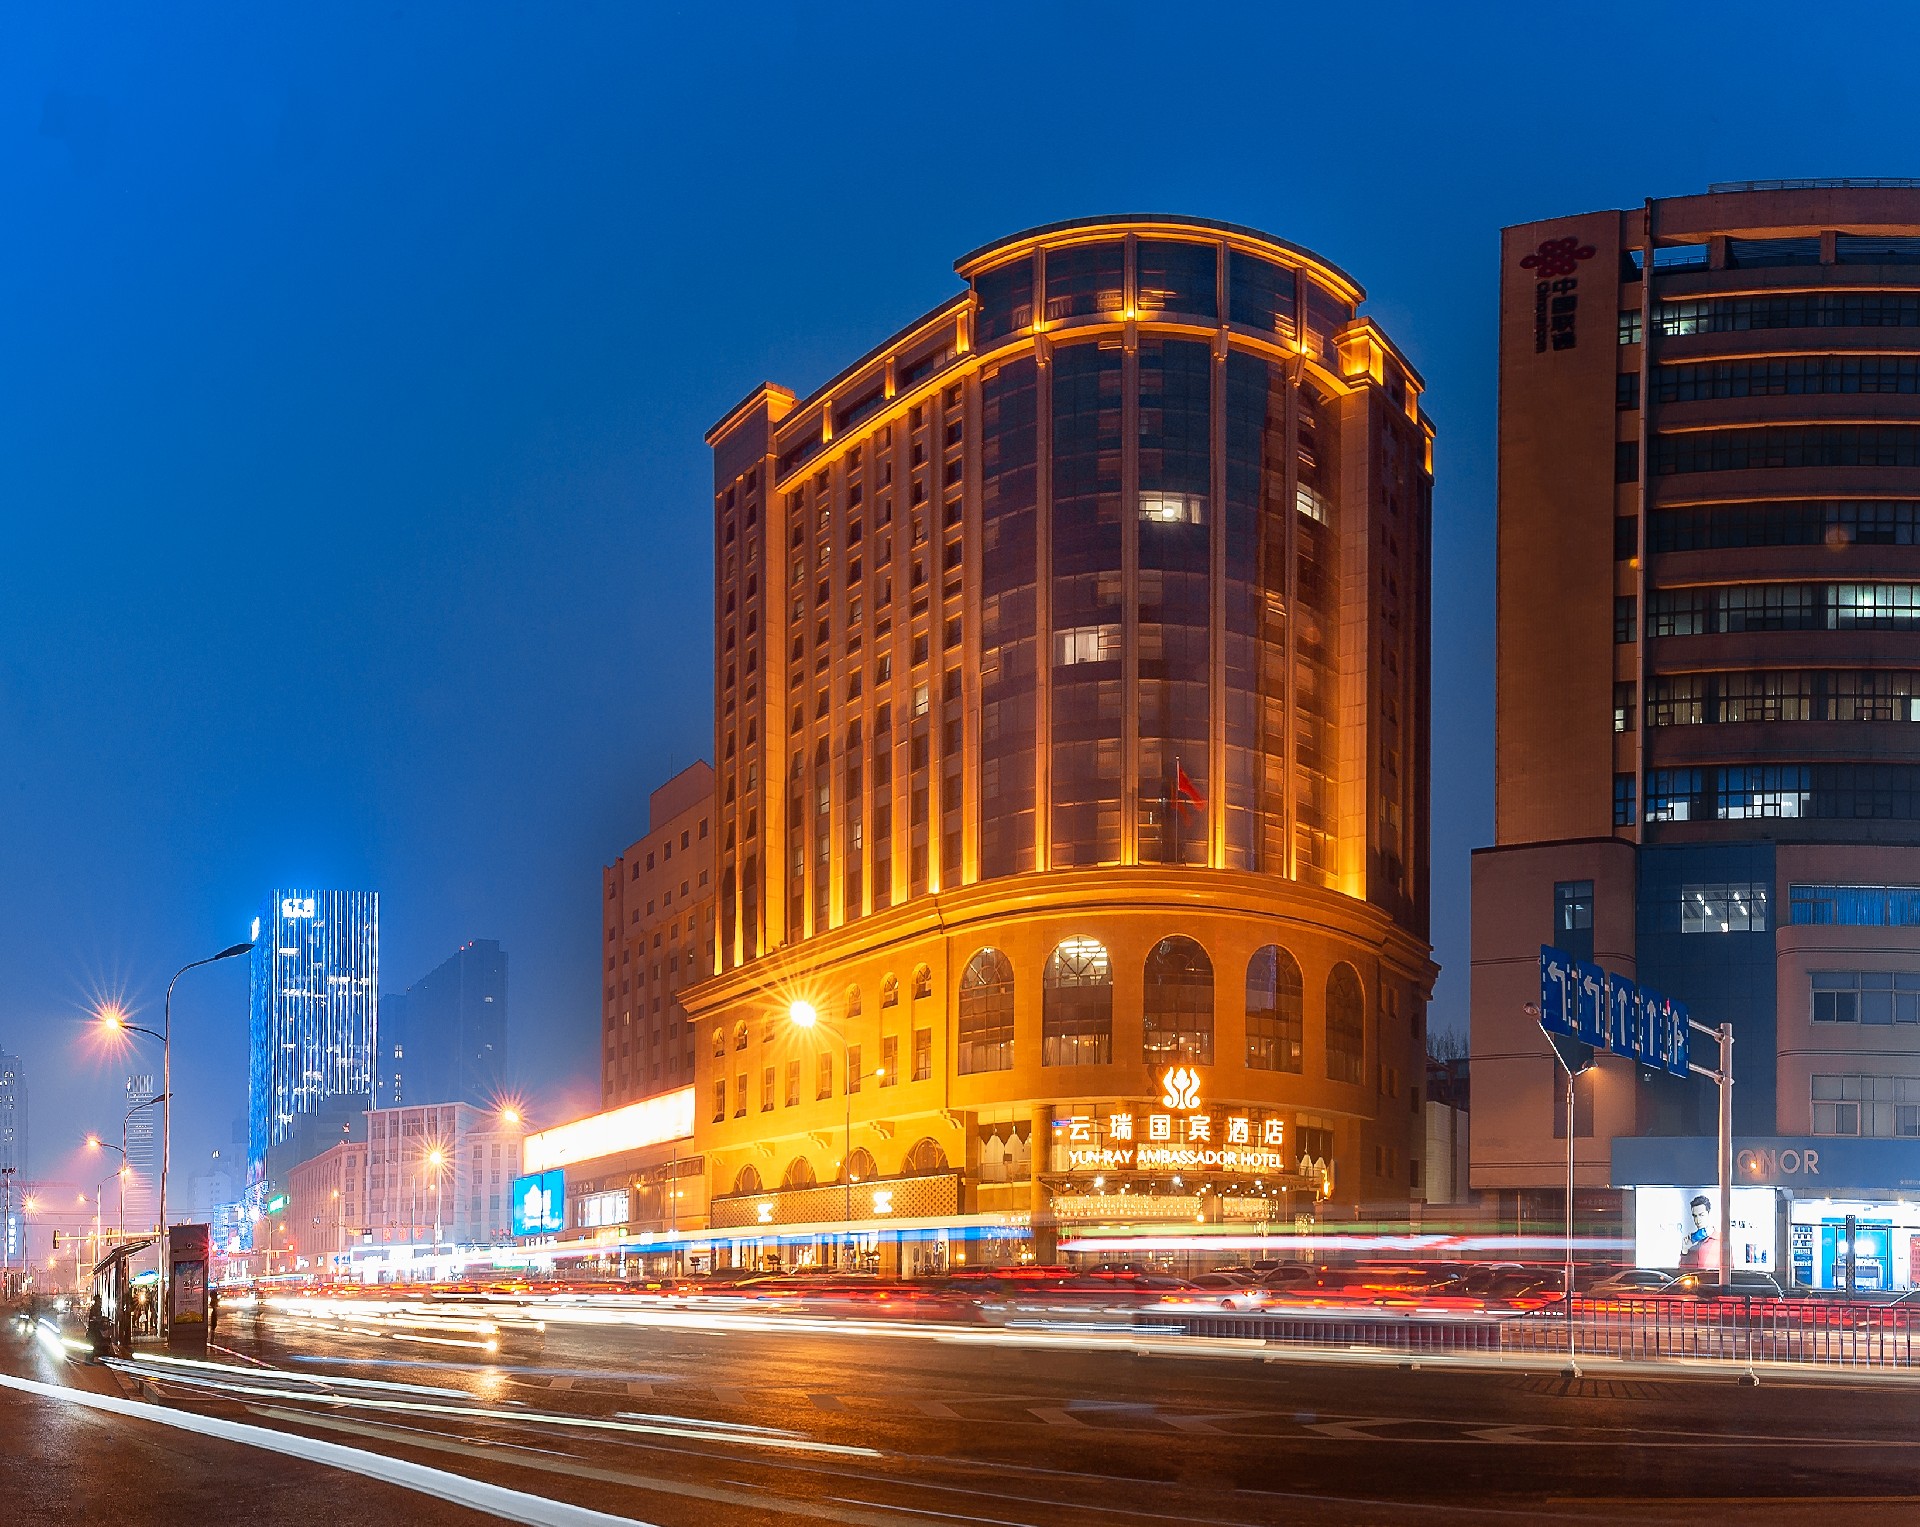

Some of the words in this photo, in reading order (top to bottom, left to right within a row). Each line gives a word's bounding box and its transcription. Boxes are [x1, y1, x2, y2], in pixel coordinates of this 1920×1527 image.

[1070, 1114, 1283, 1144] 云瑞国宾酒店
[1070, 1150, 1132, 1164] YUN-RAY
[1137, 1150, 1237, 1165] AMBASSADOR
[1241, 1153, 1284, 1168] HOTEL
[1736, 1149, 1820, 1175] ONOR
